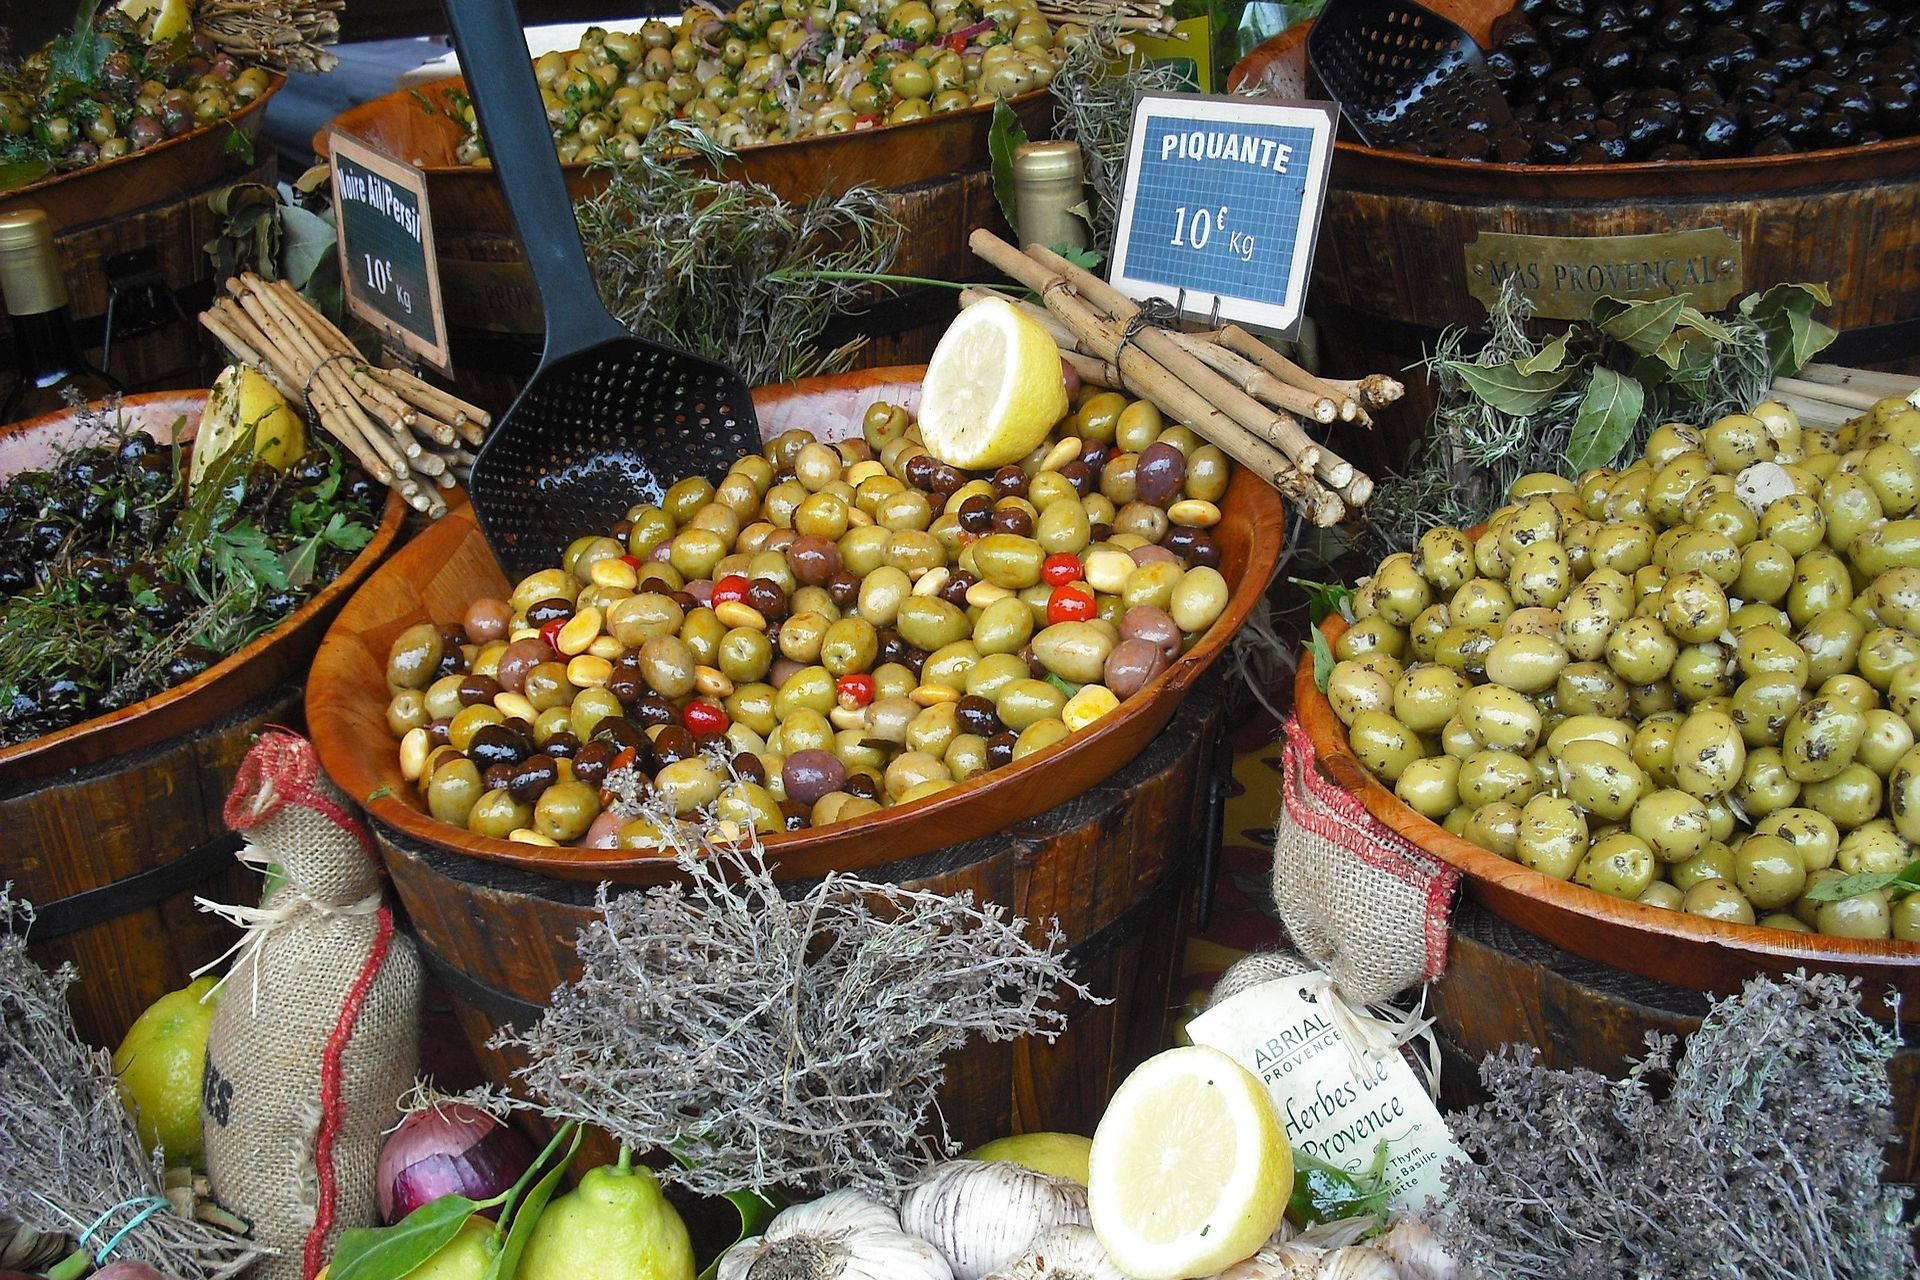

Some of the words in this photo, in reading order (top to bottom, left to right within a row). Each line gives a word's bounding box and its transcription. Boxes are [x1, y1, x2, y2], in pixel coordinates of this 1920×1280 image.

[1161, 131, 1293, 174] PIQUANTE
[337, 167, 366, 203] Noire
[367, 174, 421, 244] Ail/Persil
[1170, 206, 1229, 250] 10€
[1229, 230, 1255, 262] Kg
[396, 284, 412, 314] Kg
[1487, 258, 1541, 291] MAS
[1552, 254, 1718, 296] PROVENÇAL
[1254, 1013, 1332, 1070] ABRIAL
[1263, 1031, 1342, 1086] PROVENCE
[1285, 1079, 1357, 1141] Herbes
[1300, 1096, 1404, 1160] Provence
[1389, 1146, 1422, 1168] Thym
[1400, 1151, 1438, 1177] Basilic
